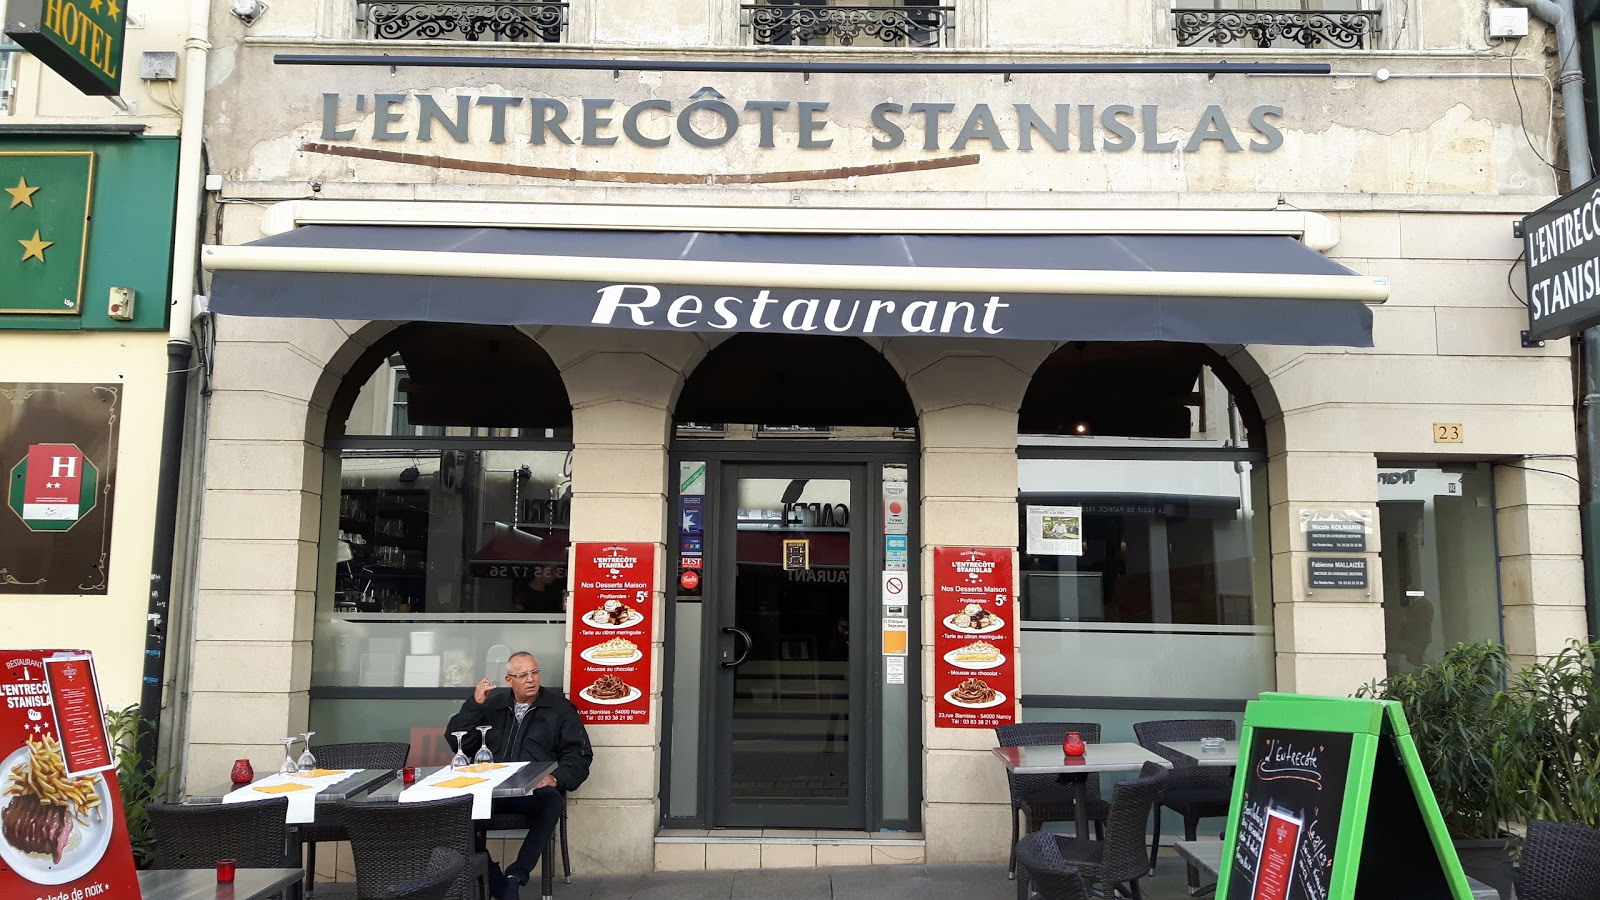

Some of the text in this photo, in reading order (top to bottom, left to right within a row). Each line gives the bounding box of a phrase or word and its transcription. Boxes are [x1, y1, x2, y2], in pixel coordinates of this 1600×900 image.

[44, 0, 117, 79] HOTEL
[319, 86, 1285, 152] L'ENTRECÔTE STANISLAS
[591, 284, 1010, 334] Restaurant
[1438, 426, 1459, 440] 23
[50, 456, 78, 478] H
[6, 659, 42, 669] RESTAURANT
[85, 882, 104, 898] noix
